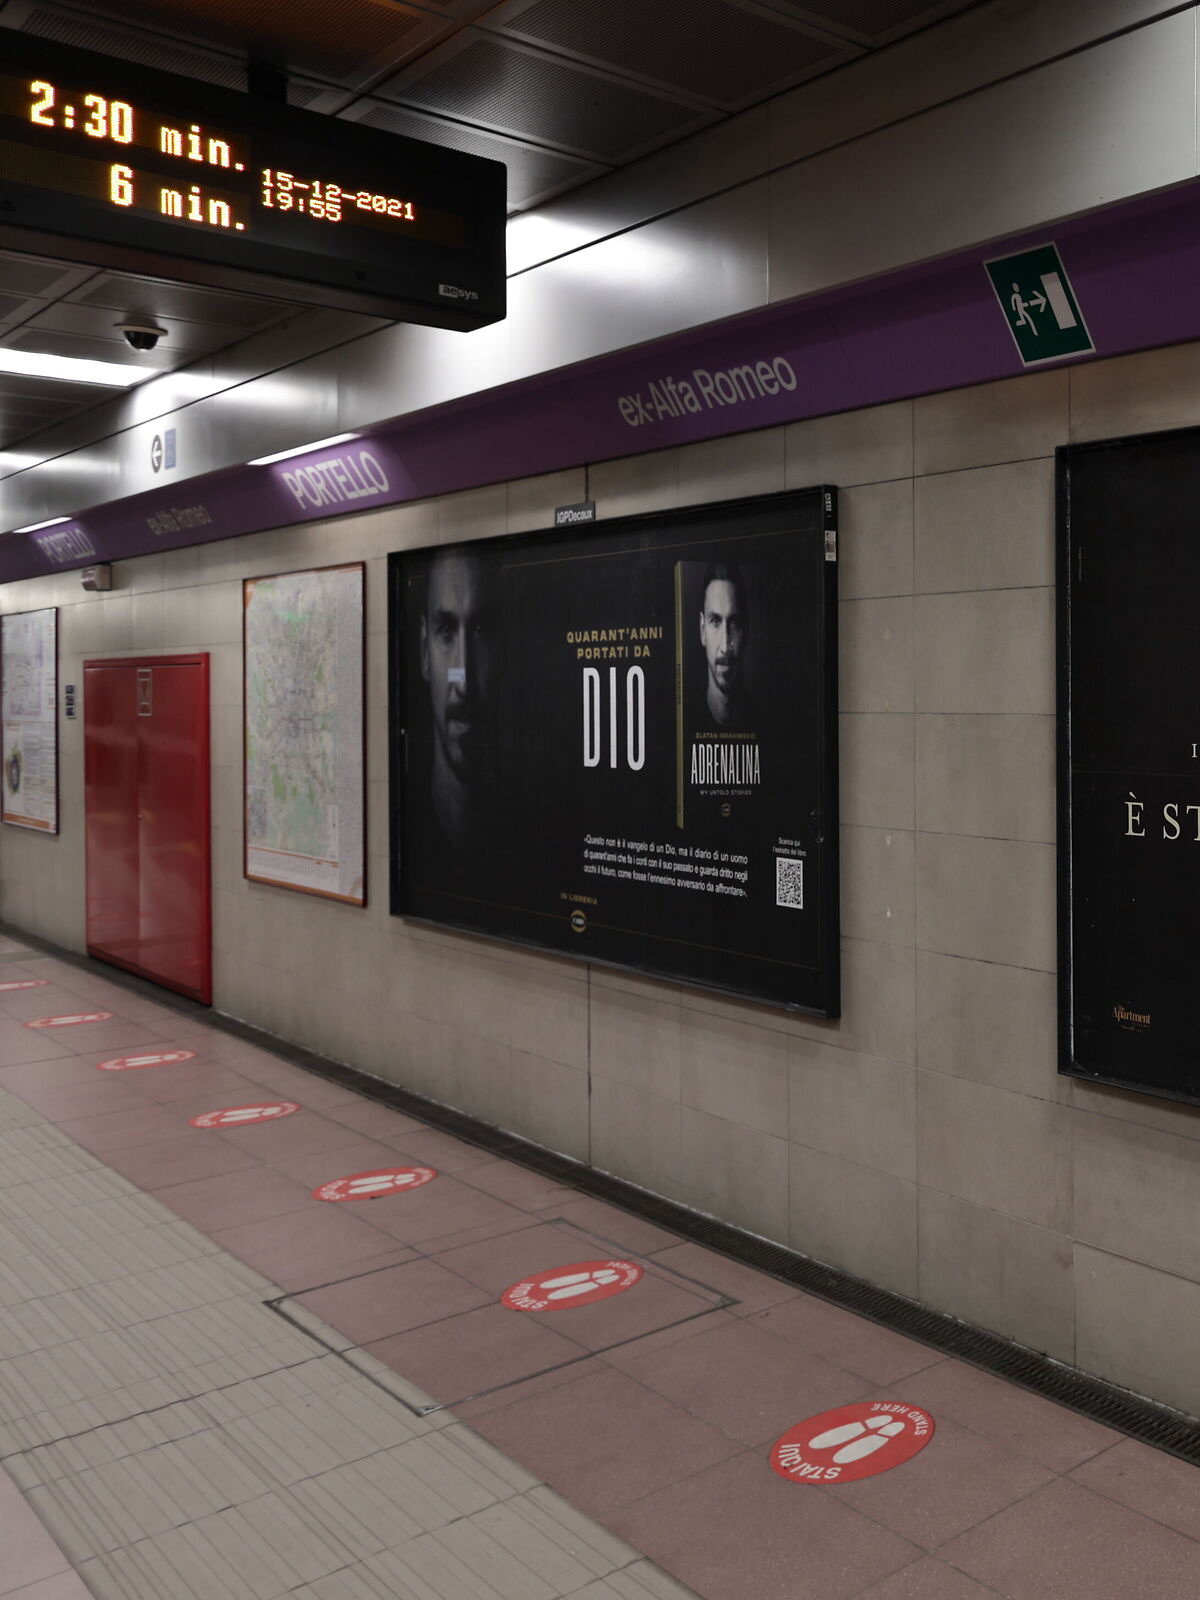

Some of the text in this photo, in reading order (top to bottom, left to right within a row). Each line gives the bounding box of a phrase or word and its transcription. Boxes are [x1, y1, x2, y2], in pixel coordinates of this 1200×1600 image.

[30, 80, 246, 172] 2:30 min.
[111, 163, 246, 231] 6 min.
[262, 168, 415, 220] 15-12-2021
[262, 188, 342, 222] 19:55
[617, 356, 798, 427] ex-Alfa Romeo
[281, 451, 390, 510] PORTELLO
[556, 510, 593, 525] IGPDecaux
[566, 626, 663, 644] QUARANT'ANNI
[577, 645, 651, 660] PORTATI DA
[583, 665, 645, 771] DIO
[691, 743, 761, 785] ADRENALINA
[1124, 791, 1146, 837] È
[627, 841, 648, 853] vangelo
[649, 842, 655, 853] di
[656, 844, 664, 853] un
[665, 843, 677, 856] Dio,
[678, 847, 688, 857] ma
[694, 848, 712, 860] diario
[713, 850, 719, 861] di
[720, 852, 728, 862] un
[730, 854, 748, 865] uomo
[662, 861, 672, 870] suo
[673, 862, 693, 873] passato
[694, 865, 699, 874] e
[699, 866, 719, 877] guarda
[706, 881, 714, 892] da
[870, 1402, 929, 1436] STAND HERE
[778, 1443, 842, 1480] STAI QUI
